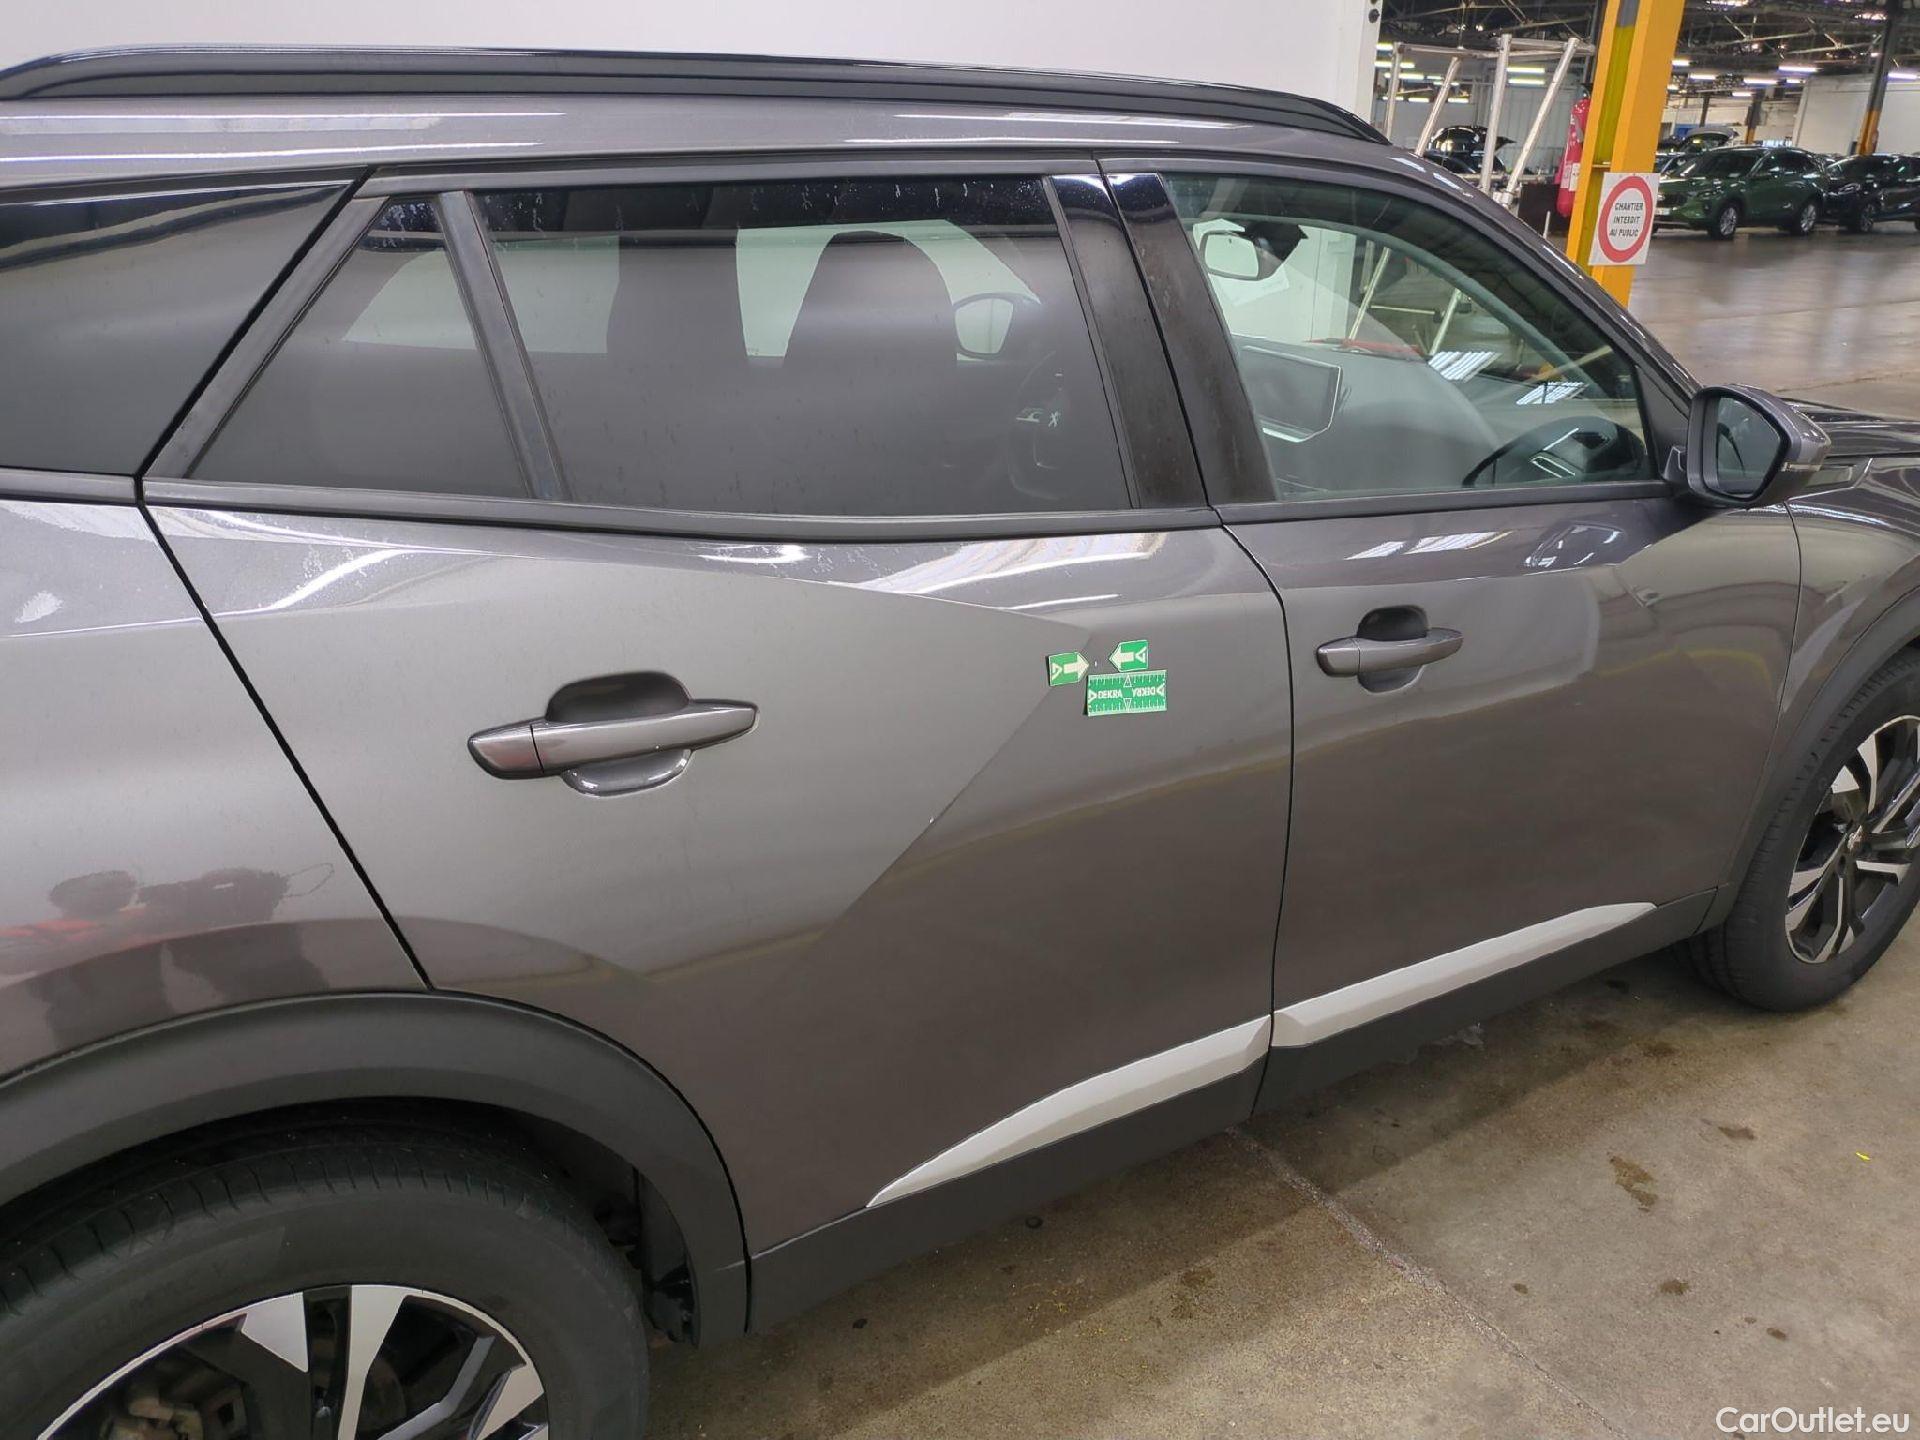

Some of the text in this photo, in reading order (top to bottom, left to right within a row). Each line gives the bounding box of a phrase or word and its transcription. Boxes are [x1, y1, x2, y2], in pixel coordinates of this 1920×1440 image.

[1615, 202, 1644, 211] CHANTIER
[1613, 216, 1641, 224] INTERDIT
[1618, 229, 1639, 237] PUBLIC
[1097, 689, 1123, 699] DEKRA
